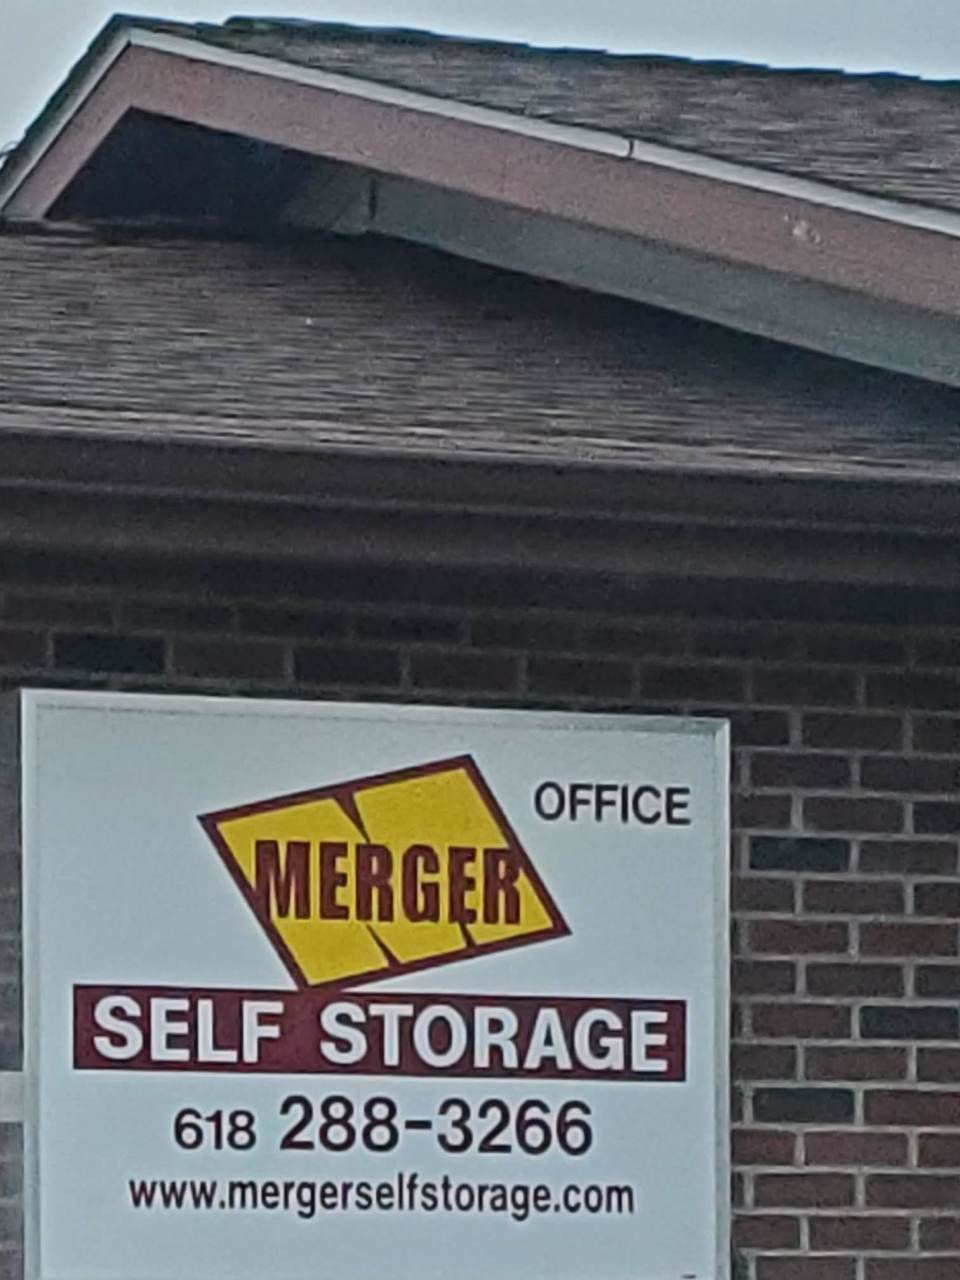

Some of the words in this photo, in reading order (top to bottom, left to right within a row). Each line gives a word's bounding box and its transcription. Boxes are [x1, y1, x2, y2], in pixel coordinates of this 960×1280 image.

[533, 781, 693, 827] OFFICE
[253, 839, 523, 926] MERGER
[92, 995, 284, 1065] SELF
[319, 1002, 670, 1073] STORAGE
[173, 1109, 257, 1151] 618
[278, 1094, 594, 1157] 288-3266
[128, 1173, 635, 1220] www.mergerselfstorage.com
